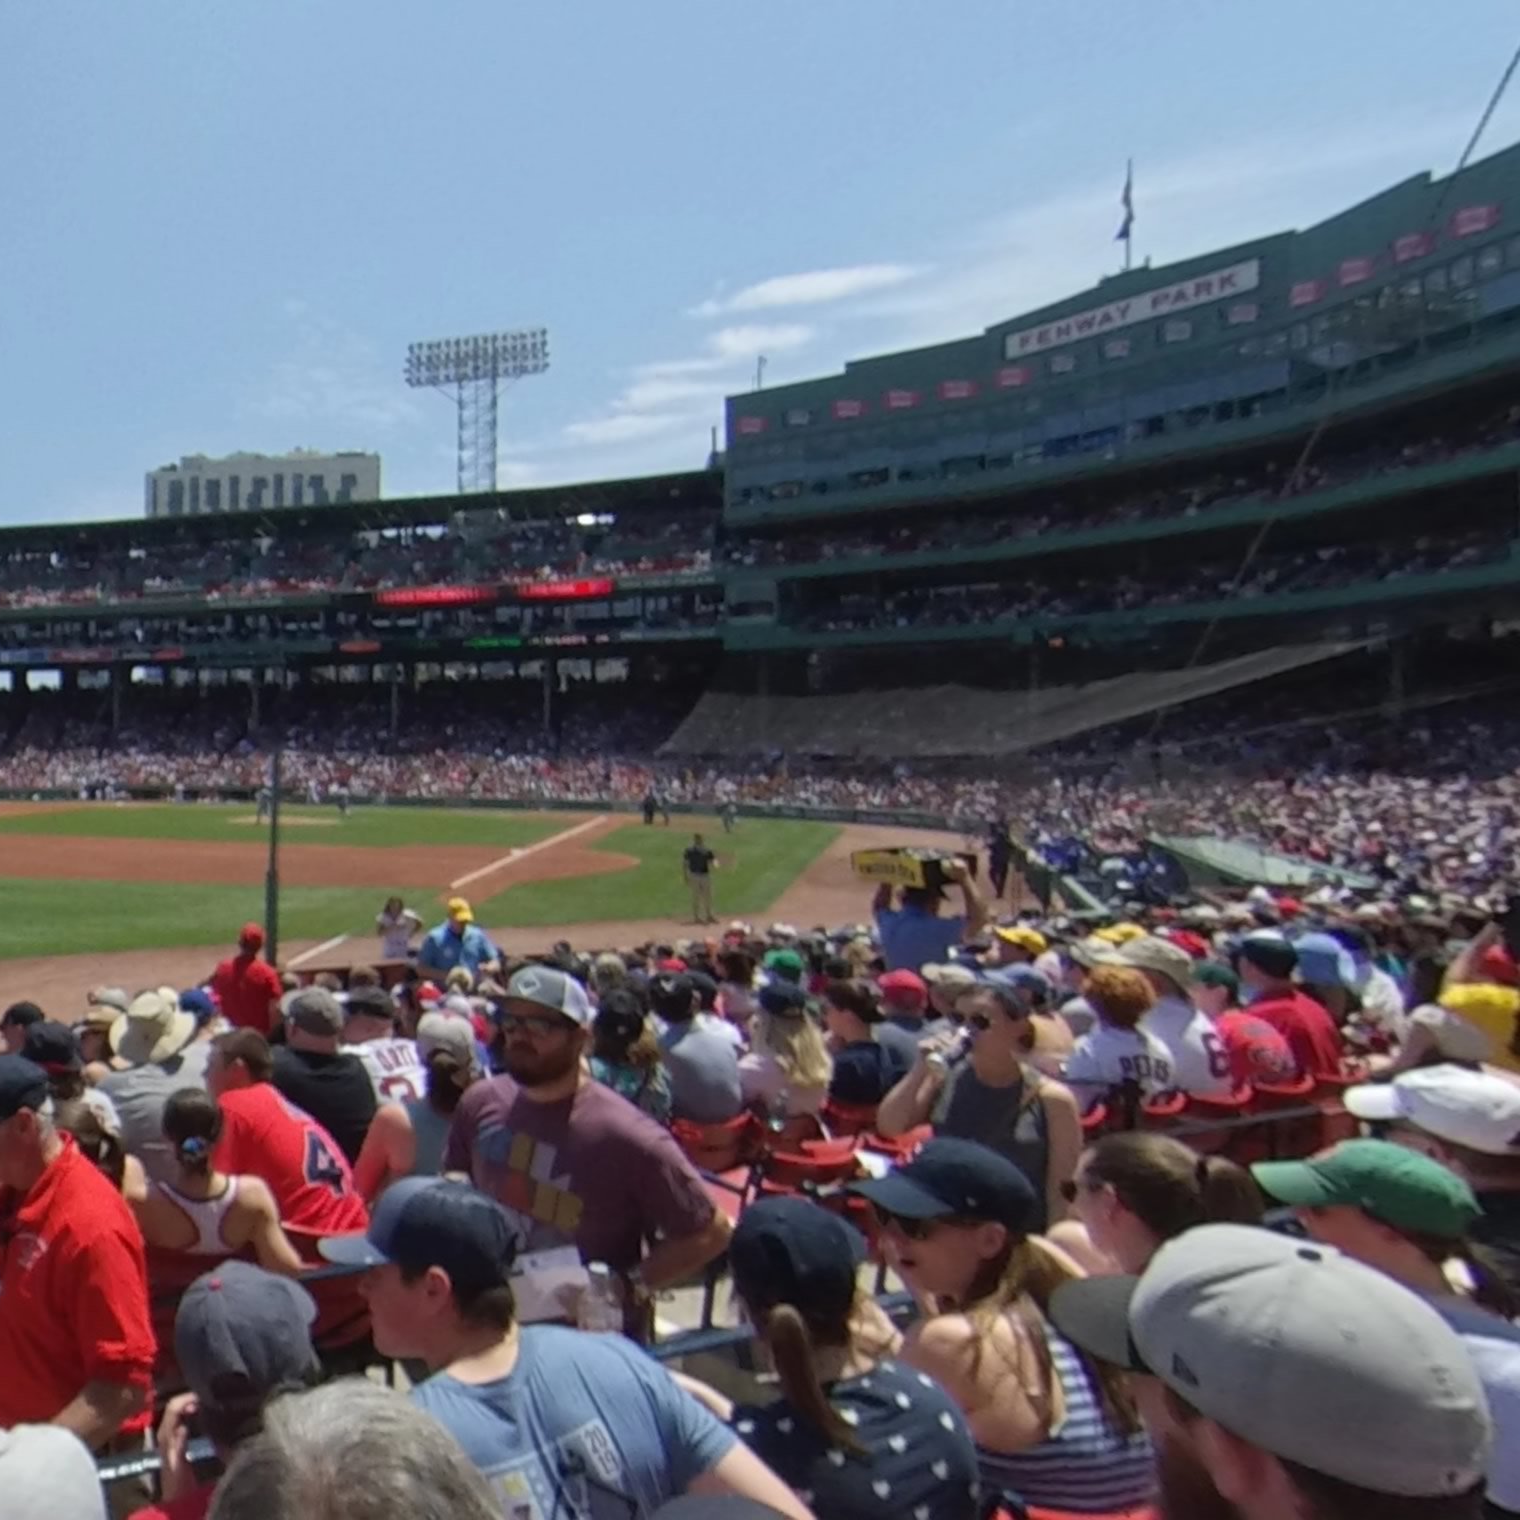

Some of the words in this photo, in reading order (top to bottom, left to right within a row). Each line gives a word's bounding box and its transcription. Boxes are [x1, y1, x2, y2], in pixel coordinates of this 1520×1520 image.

[1018, 303, 1130, 350] FENWAY
[1150, 271, 1238, 311] PARK
[303, 1127, 348, 1198] 4
